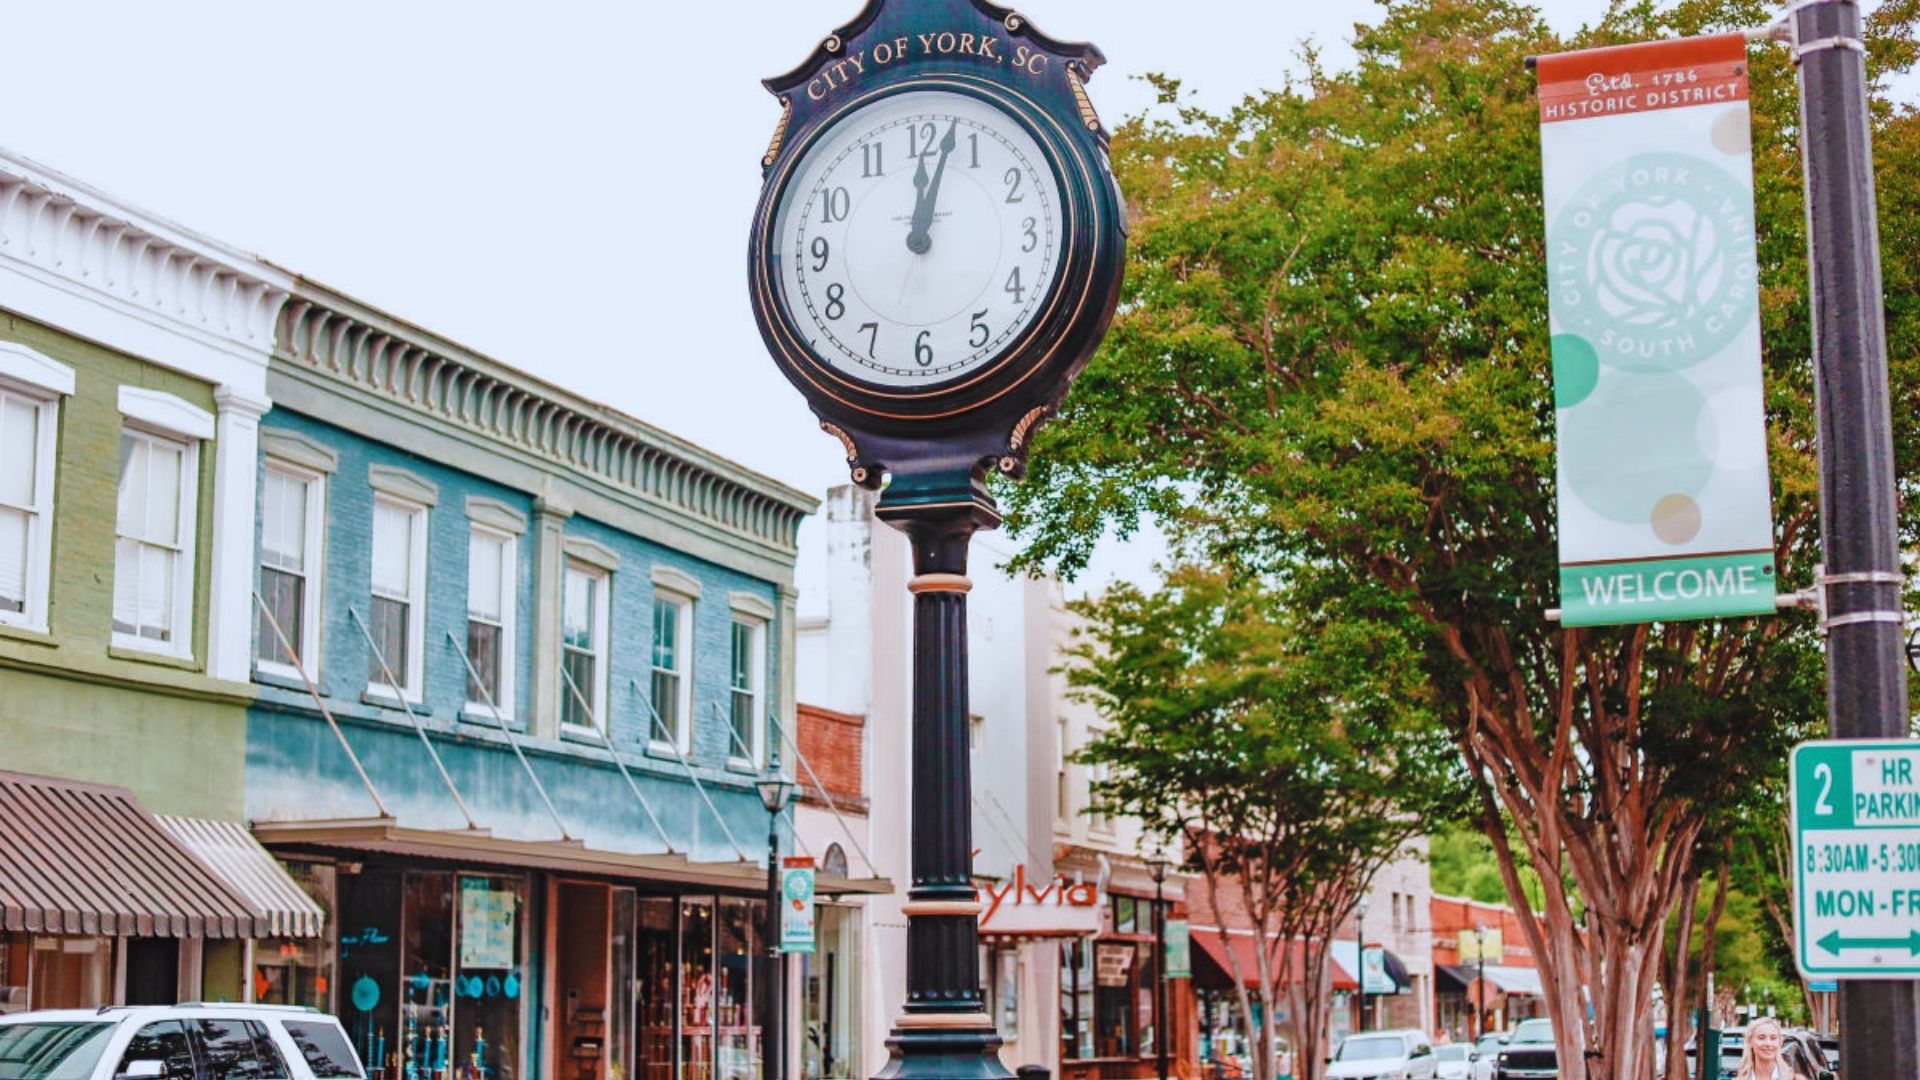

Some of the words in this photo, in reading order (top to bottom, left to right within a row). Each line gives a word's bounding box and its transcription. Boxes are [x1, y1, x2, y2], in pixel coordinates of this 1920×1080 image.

[807, 51, 865, 100] CITY
[873, 37, 908, 64] OF
[917, 32, 1003, 63] YORK,
[1012, 46, 1049, 75] SC
[1651, 69, 1698, 87] 1786
[1545, 95, 1638, 118] HISTORIC
[1647, 83, 1739, 106] DISTRICT
[860, 141, 885, 178] 11
[906, 122, 938, 160] 12
[967, 133, 982, 170] 1
[820, 186, 851, 223] 10
[1004, 168, 1025, 205] 2
[1021, 217, 1038, 253] 3
[1558, 241, 1581, 306] CITY
[1573, 194, 1601, 228] OF
[1610, 166, 1691, 193] YORK
[810, 236, 829, 272] 9
[1004, 266, 1025, 304] 4
[1600, 328, 1697, 358] SOUTH
[1705, 197, 1754, 335] CAROLINA
[825, 283, 846, 321] 8
[857, 322, 879, 359] 7
[968, 308, 990, 348] 5
[913, 331, 933, 367] 6
[1581, 565, 1759, 606] WELCOME
[1813, 762, 1834, 816] 2
[1882, 758, 1913, 786] HR
[975, 863, 1098, 927] ylvia
